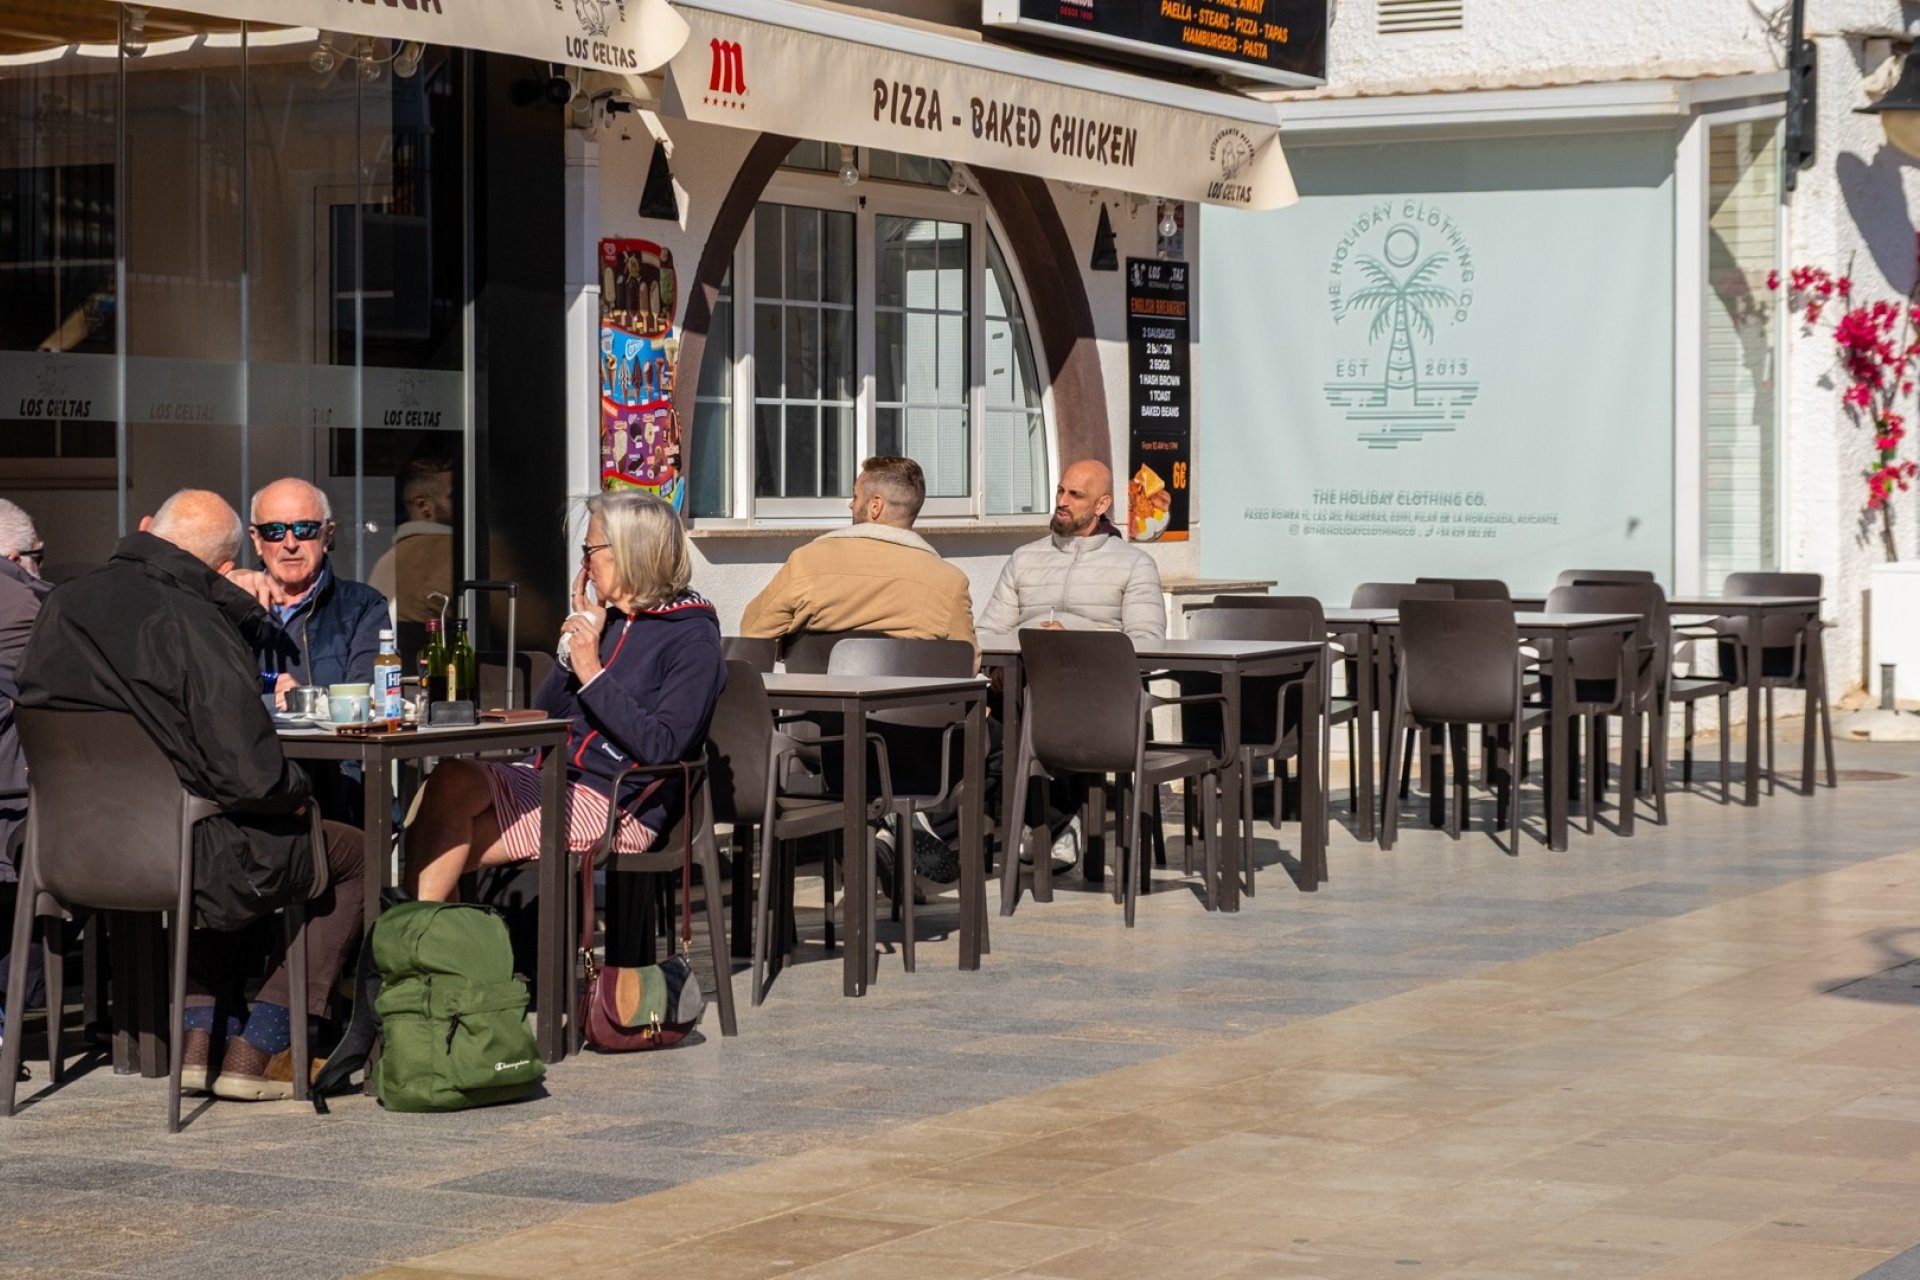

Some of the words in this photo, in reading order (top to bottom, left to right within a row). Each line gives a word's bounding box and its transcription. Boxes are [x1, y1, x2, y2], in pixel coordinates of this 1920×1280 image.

[1160, 1, 1192, 21] PAELLA
[1198, 9, 1230, 29] STEAKS
[1235, 17, 1258, 35] PIZZA
[1263, 23, 1289, 43] TAPAS
[1183, 26, 1237, 52] HAMBURGERS
[1243, 40, 1268, 59] PASTA
[565, 35, 589, 61] LOS
[592, 41, 638, 69] CELTAS
[873, 78, 943, 132] PIZZA
[970, 96, 1041, 149] BAKED
[1050, 113, 1137, 168] CHICKEN
[1207, 181, 1224, 199] LOS
[1222, 183, 1253, 203] CELTAS
[1330, 203, 1393, 275] HOLIDAY
[1402, 202, 1475, 283] CLOTHING
[1148, 265, 1161, 279] LOS
[1131, 297, 1155, 313] ENGLISH
[1156, 299, 1186, 316] BREAKFAST
[1329, 284, 1346, 325] THE
[1147, 328, 1176, 339] SAUSAGES
[1151, 344, 1173, 355] BACON
[1154, 359, 1171, 370] EGGS
[1336, 362, 1369, 377] EST
[1143, 374, 1158, 385] HASH
[1159, 375, 1180, 386] BROWN
[1153, 391, 1171, 402] TOAST
[19, 399, 42, 416] LOS
[46, 400, 92, 417] CELTAS
[1141, 406, 1160, 417] BAKED
[1160, 407, 1180, 418] BEANS
[384, 409, 403, 426] LOS
[405, 411, 442, 427] CELTAS
[1173, 461, 1187, 489] 6€
[1313, 491, 1336, 505] THE
[1339, 491, 1394, 505] HOLIDAY
[1397, 492, 1462, 506] CLOTHING
[1465, 492, 1488, 506] CO.
